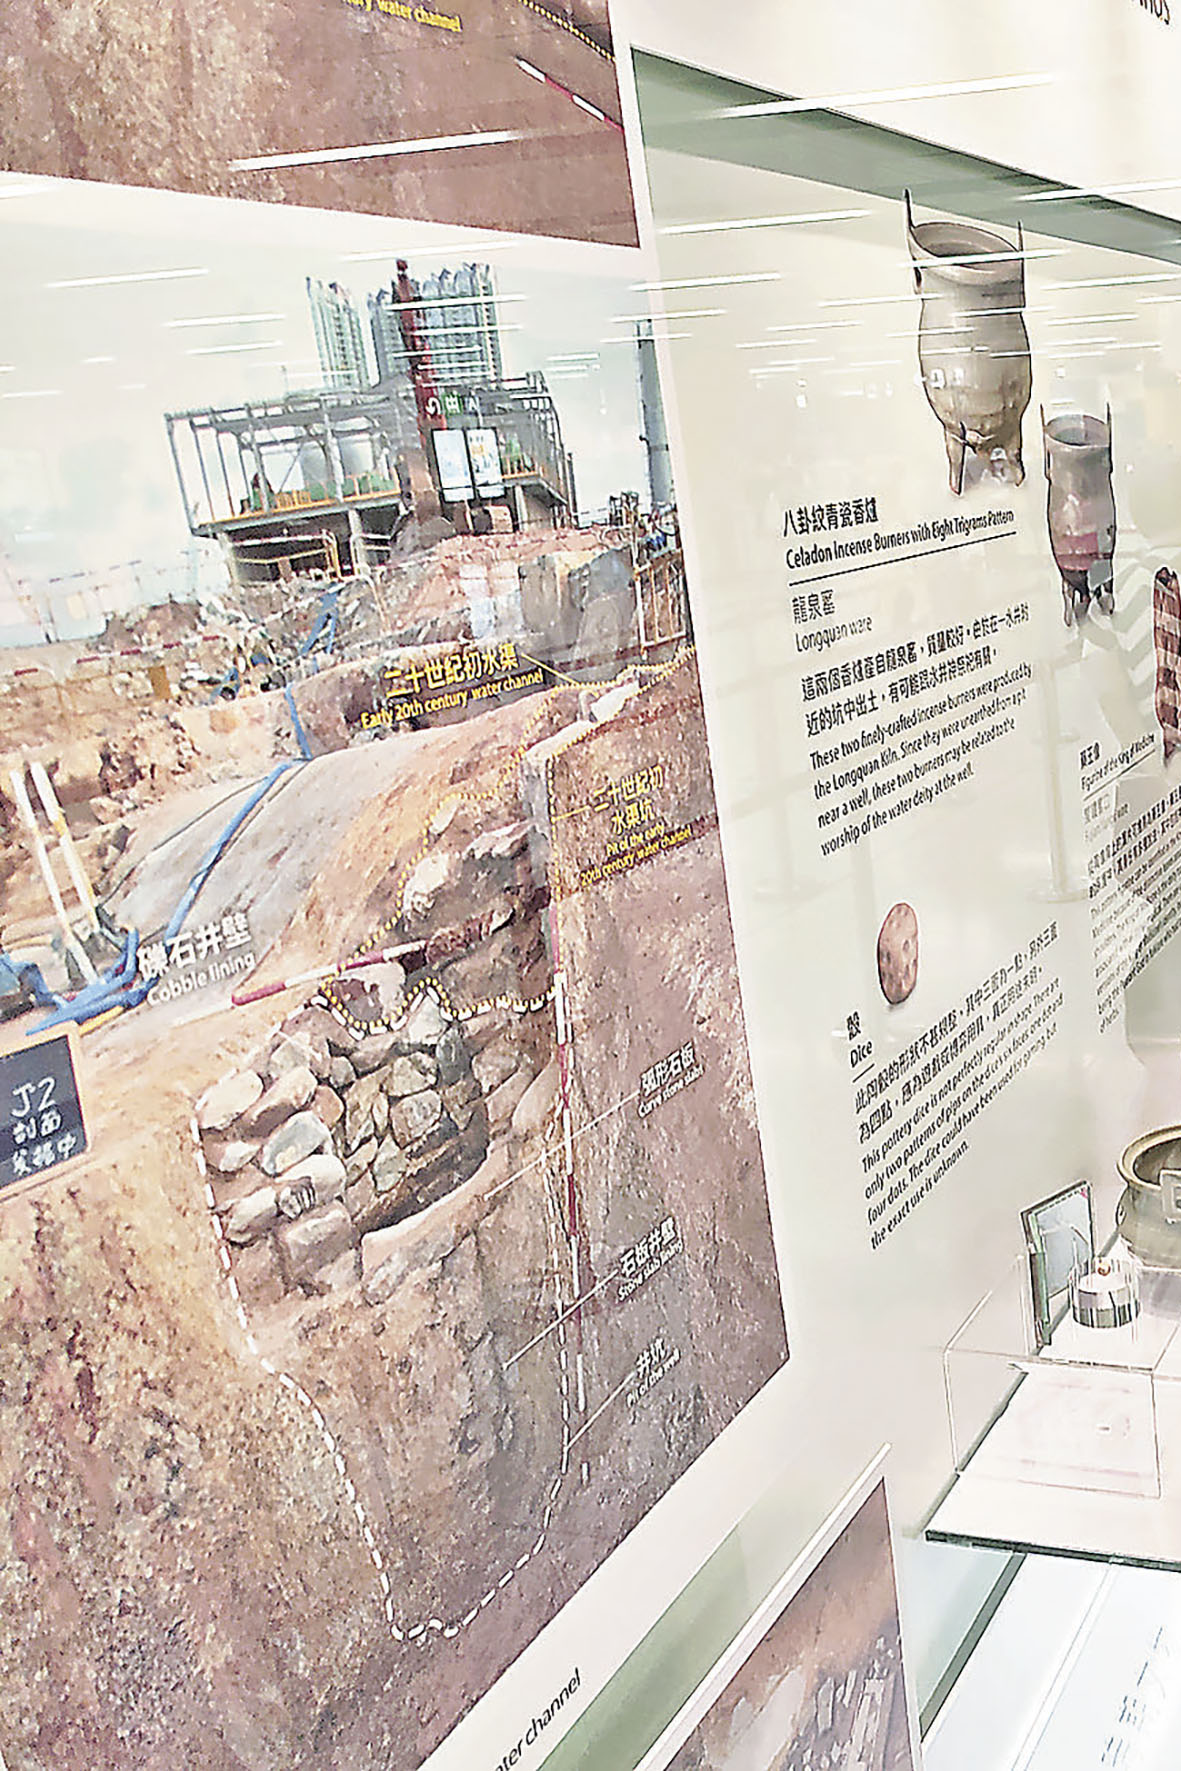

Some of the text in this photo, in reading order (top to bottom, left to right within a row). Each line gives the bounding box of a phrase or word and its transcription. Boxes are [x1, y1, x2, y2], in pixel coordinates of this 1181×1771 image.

[787, 511, 1014, 569] Celadon Incense Burners with Eight Trigrams Pattern
[796, 617, 872, 652] Longquan ware
[361, 668, 545, 730] Early 20th century water channel
[810, 748, 839, 770] These
[841, 739, 859, 757] two
[862, 709, 917, 748] finely-crafted
[918, 701, 946, 723] incense
[947, 688, 975, 709] burners
[977, 681, 992, 696] were
[814, 780, 831, 799] the
[833, 759, 880, 790] Longquan
[900, 739, 922, 758] Since
[923, 730, 940, 747] they
[942, 721, 959, 738] were
[961, 700, 996, 729] unearthed
[818, 807, 839, 828] near
[842, 803, 848, 815] a
[872, 779, 895, 800] these
[897, 770, 913, 787] two
[914, 754, 944, 778] burners
[821, 825, 859, 855] worship
[861, 815, 870, 835] of
[873, 811, 887, 828] the
[888, 798, 911, 819] water
[913, 787, 933, 806] deity
[935, 780, 943, 795] at
[943, 774, 956, 790] the
[602, 853, 635, 877] century
[637, 841, 660, 859] water
[661, 825, 692, 848] channel
[147, 951, 257, 1006] Cobble lining
[850, 1038, 874, 1069] Dice
[11, 1077, 57, 1117] J2
[862, 1149, 880, 1173] This
[882, 1118, 911, 1159] pottery
[913, 1102, 929, 1124] dice
[931, 1094, 937, 1108] is
[939, 1080, 951, 1101] not
[953, 1051, 982, 1091] perfectly
[866, 1173, 884, 1199] only
[886, 1156, 902, 1179] two
[904, 1122, 936, 1165] patterns
[937, 1108, 944, 1128] of
[946, 1096, 961, 1122] pips
[963, 1087, 972, 1102] on
[868, 1198, 886, 1225] four
[909, 1161, 923, 1182] The
[924, 1143, 940, 1166] dice
[942, 1117, 962, 1148] could
[963, 1103, 979, 1126] have
[980, 1086, 997, 1108] been
[871, 1228, 886, 1249] the
[888, 1201, 910, 1232] exact
[911, 1186, 924, 1207] use
[925, 1178, 932, 1192] is
[495, 1667, 581, 1771] ter channel
